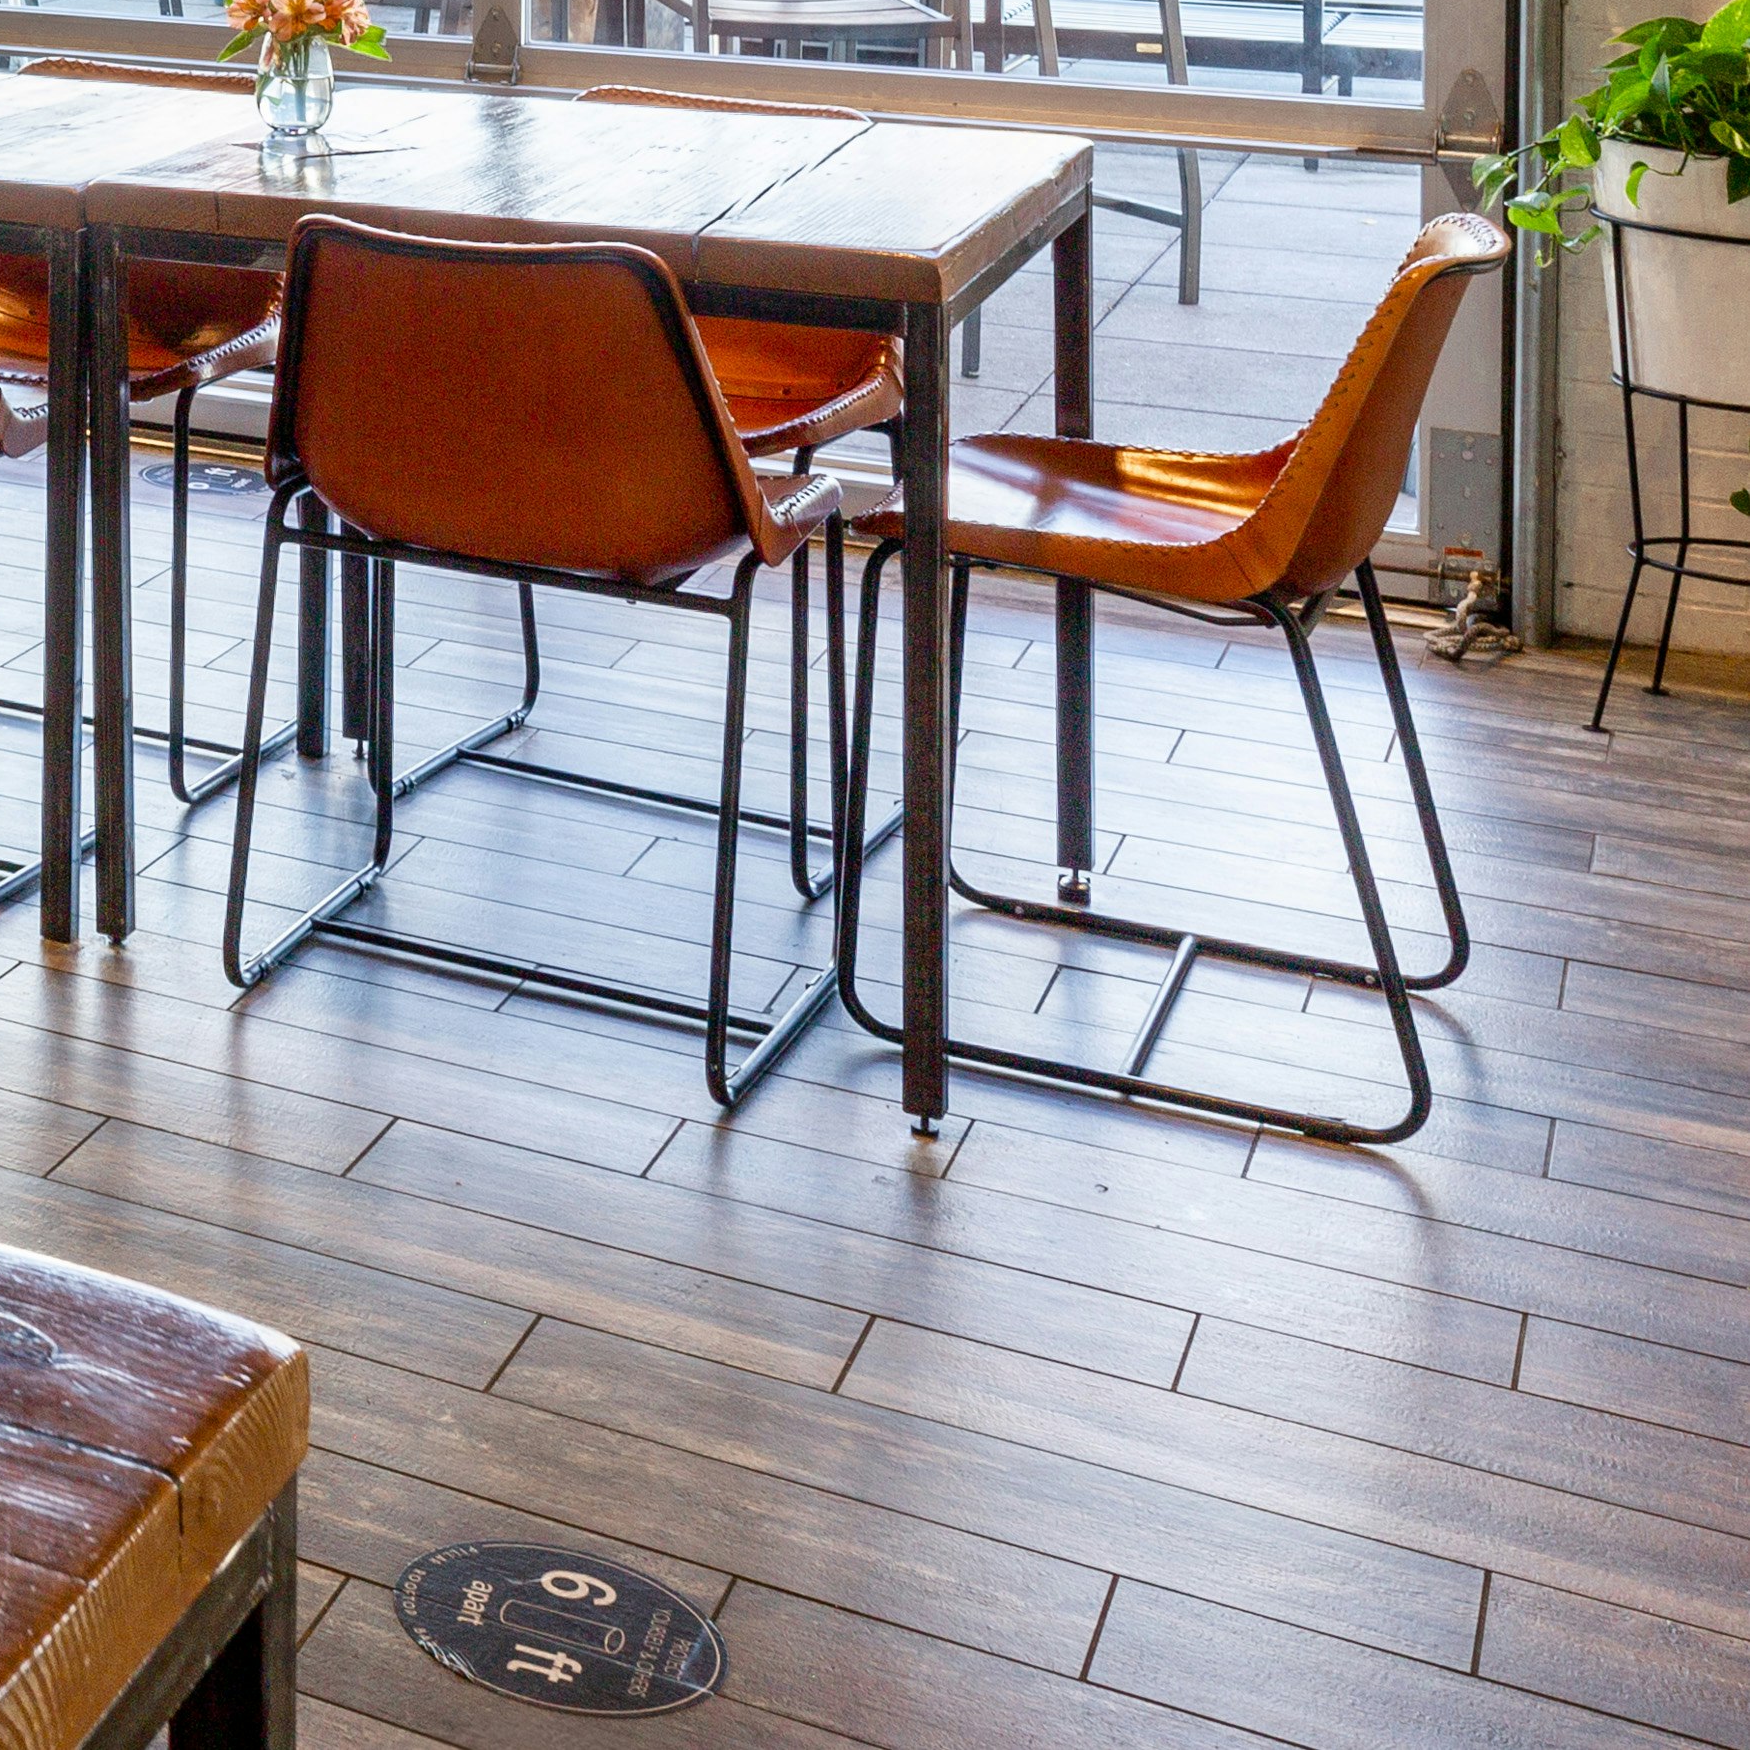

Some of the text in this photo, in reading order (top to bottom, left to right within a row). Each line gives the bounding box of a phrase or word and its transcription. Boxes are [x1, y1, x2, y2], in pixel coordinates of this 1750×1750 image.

[402, 1568, 427, 1616] ROOFTOP
[457, 1580, 494, 1626] apart
[506, 1569, 617, 1684] 6 ft
[643, 1609, 673, 1653] YOURSELF
[627, 1660, 655, 1698] OTHERS
[664, 1637, 693, 1682] PROTECT
